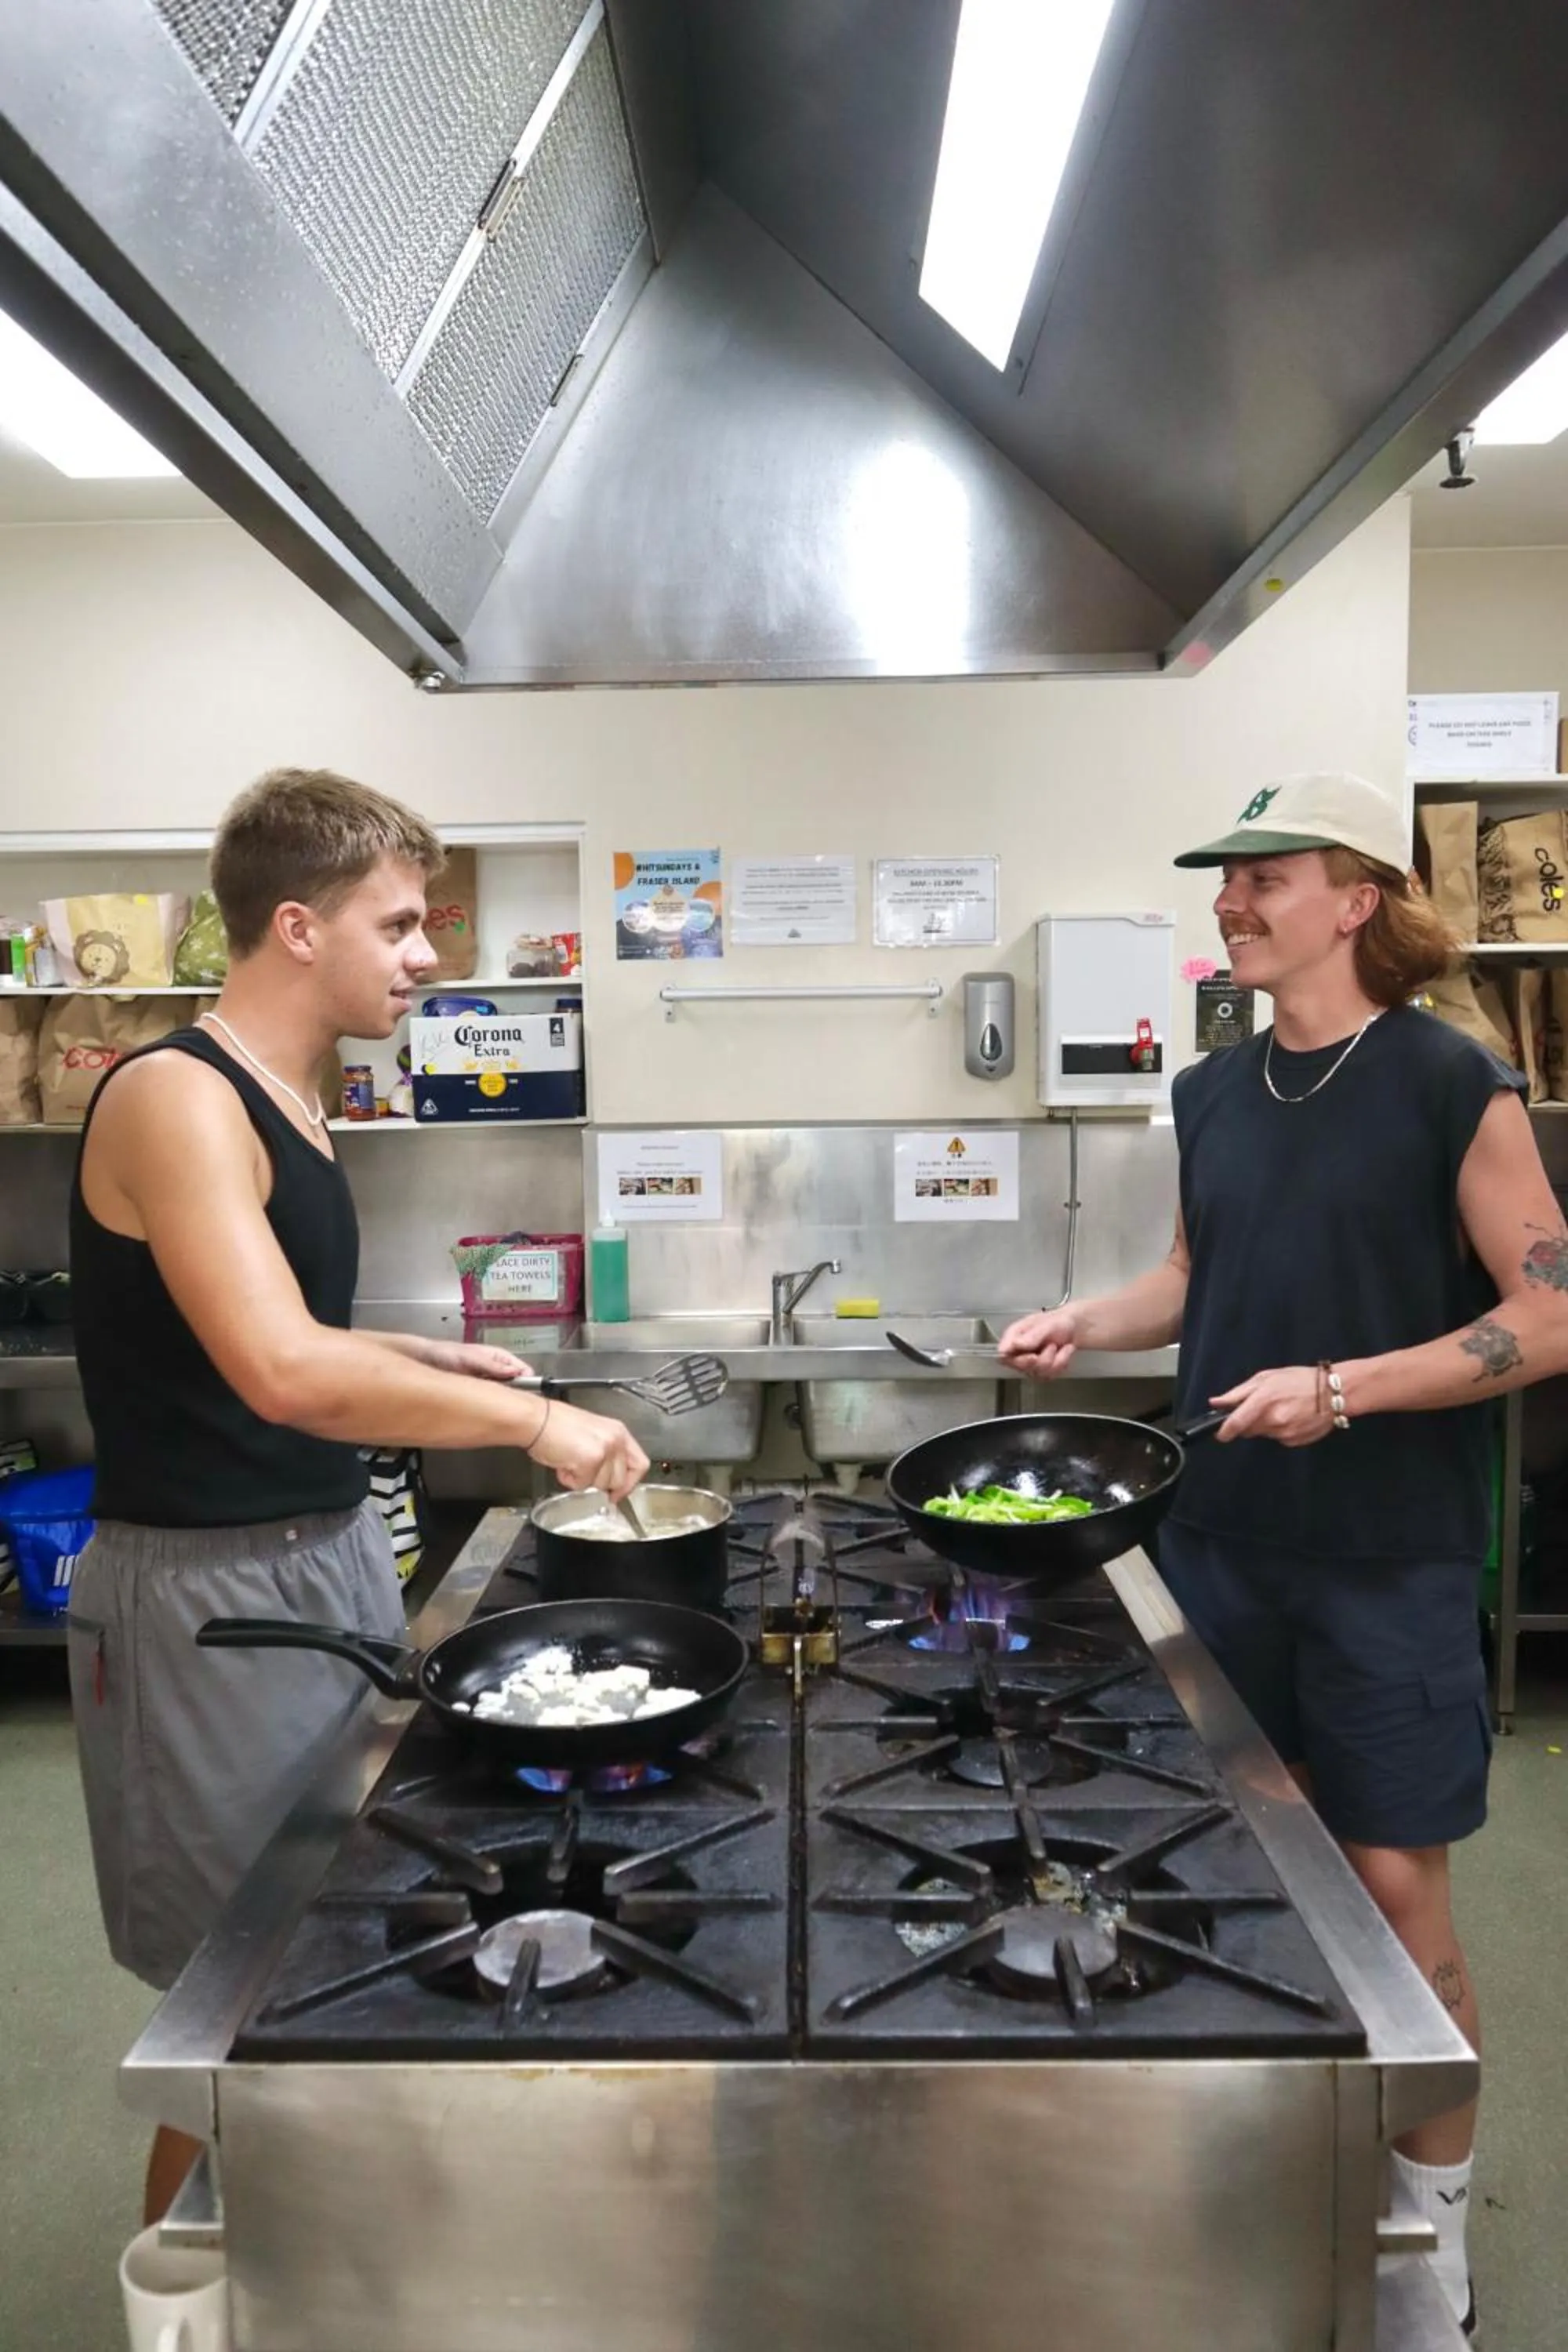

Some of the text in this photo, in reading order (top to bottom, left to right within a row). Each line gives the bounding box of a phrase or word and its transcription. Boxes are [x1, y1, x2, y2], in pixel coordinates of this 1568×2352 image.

[636, 863, 692, 872] WHITSUNDAYS
[672, 877, 701, 885] ISLAND
[1534, 848, 1565, 912] coles
[422, 904, 465, 930] es
[455, 1025, 525, 1047] Corona
[474, 1044, 510, 1058] Extra
[63, 1046, 122, 1069] col
[495, 1257, 550, 1267] LACE DIRTY
[491, 1270, 551, 1280] TEA TOWELS
[508, 1284, 532, 1293] HERE
